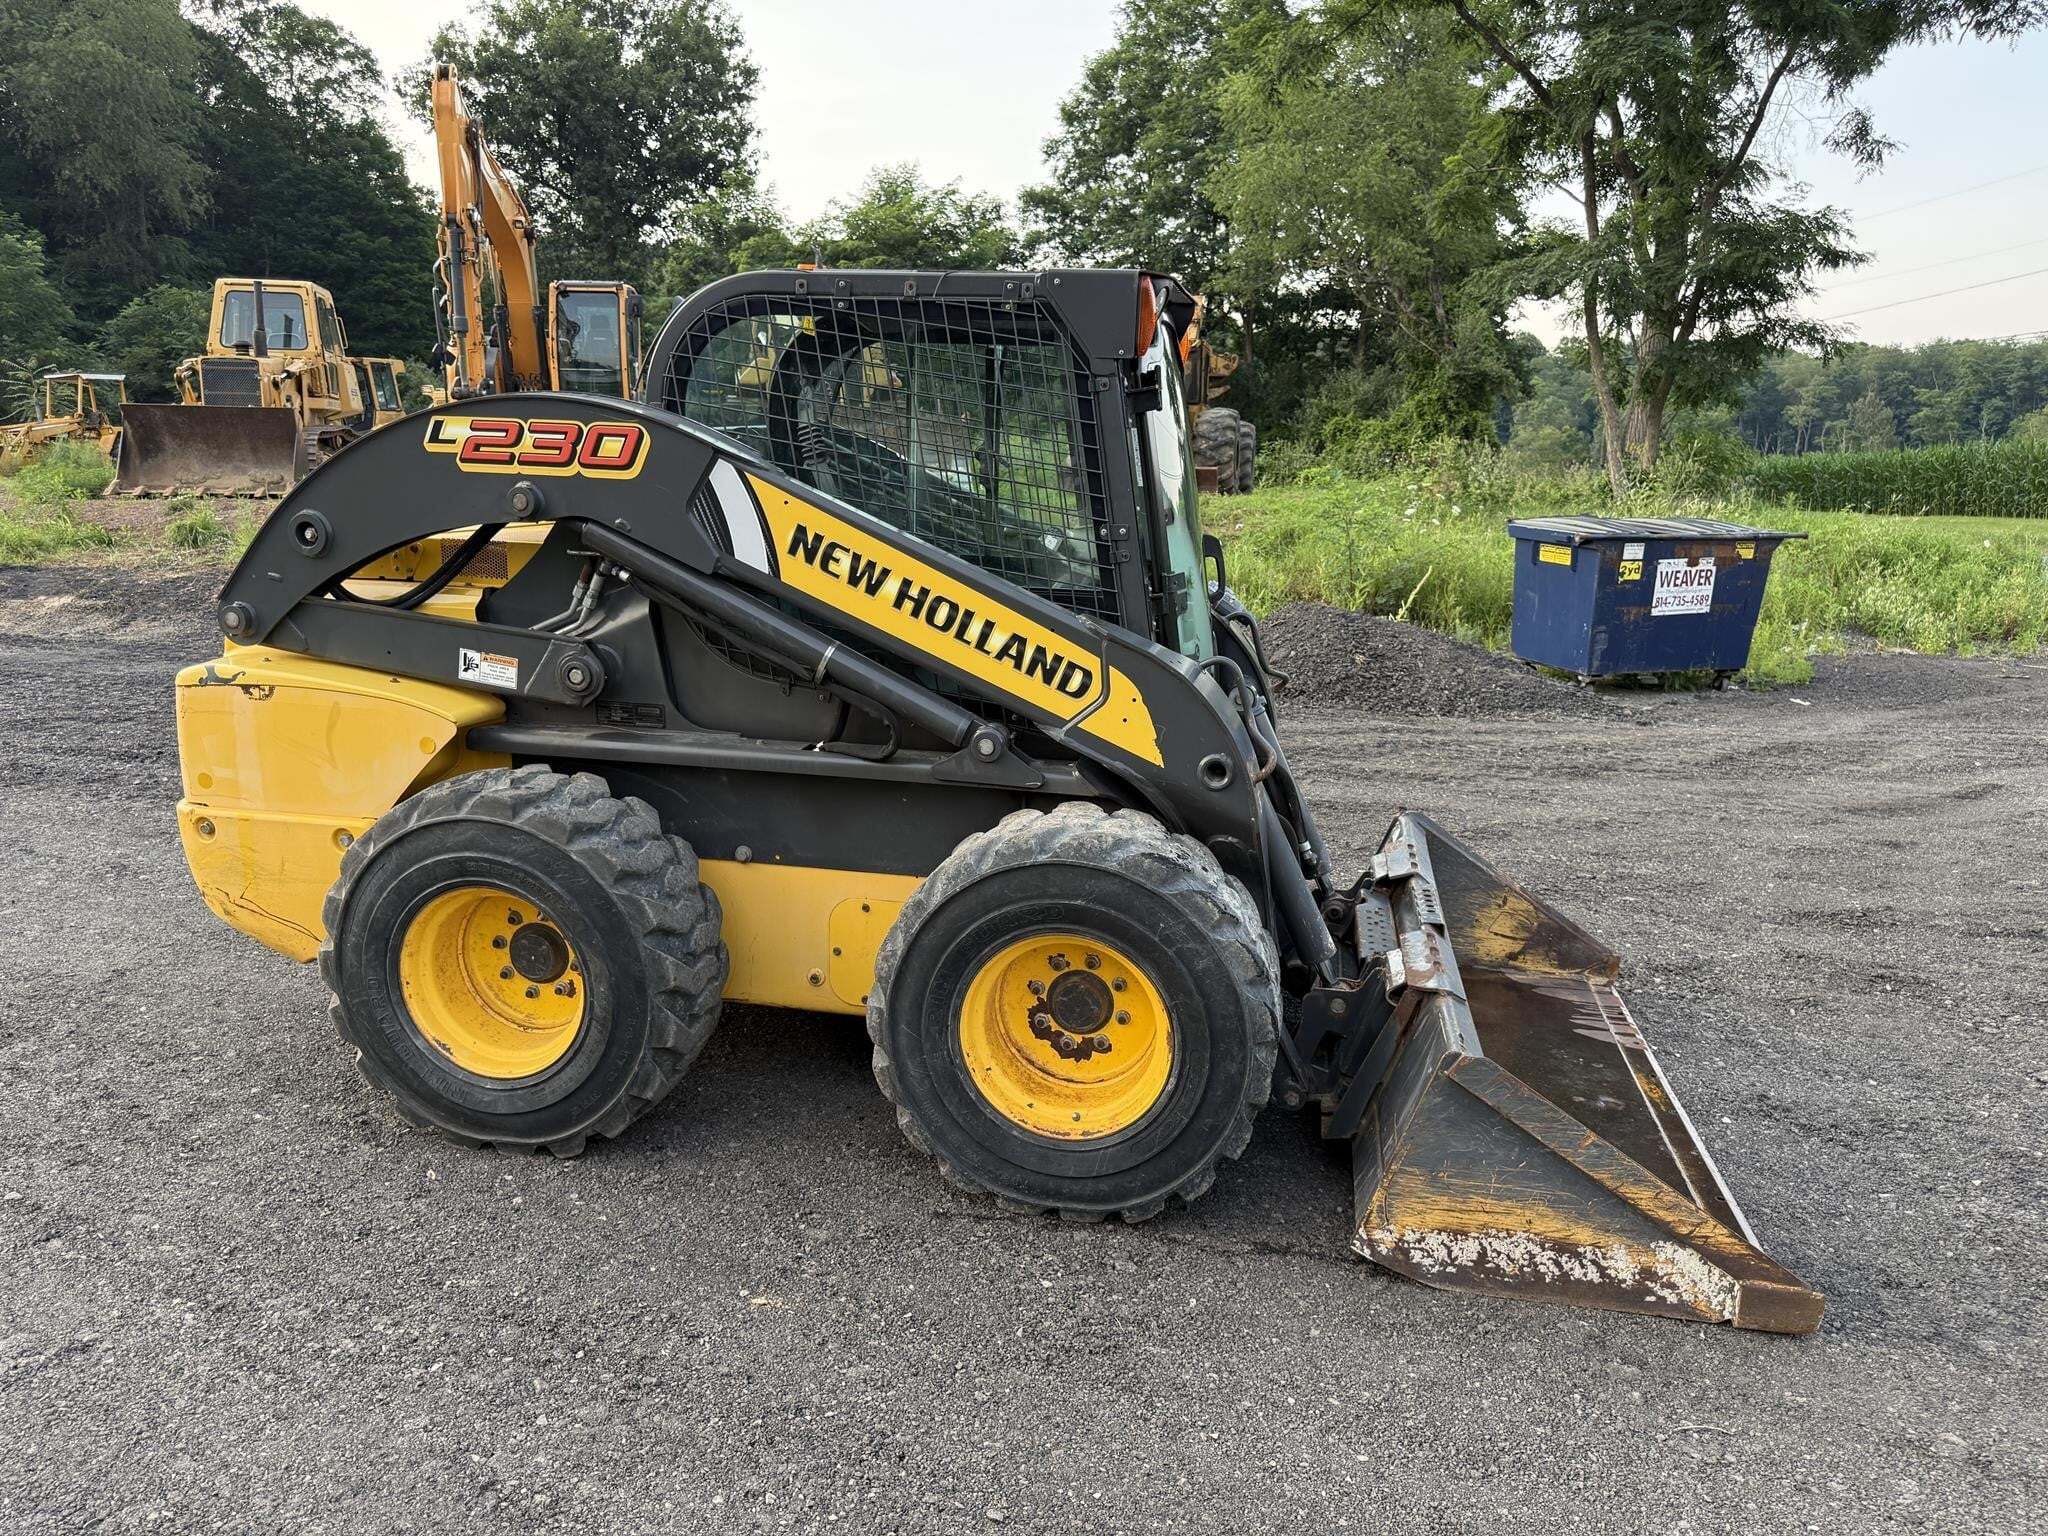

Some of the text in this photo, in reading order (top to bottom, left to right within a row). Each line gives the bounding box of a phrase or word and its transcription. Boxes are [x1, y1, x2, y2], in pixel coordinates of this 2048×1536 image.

[428, 418, 645, 471] L230
[1660, 568, 1713, 588] WEAVER
[1654, 594, 1710, 608] 814-735-4589
[787, 523, 1094, 700] NEW HOLLAND
[489, 655, 515, 666] WARNING
